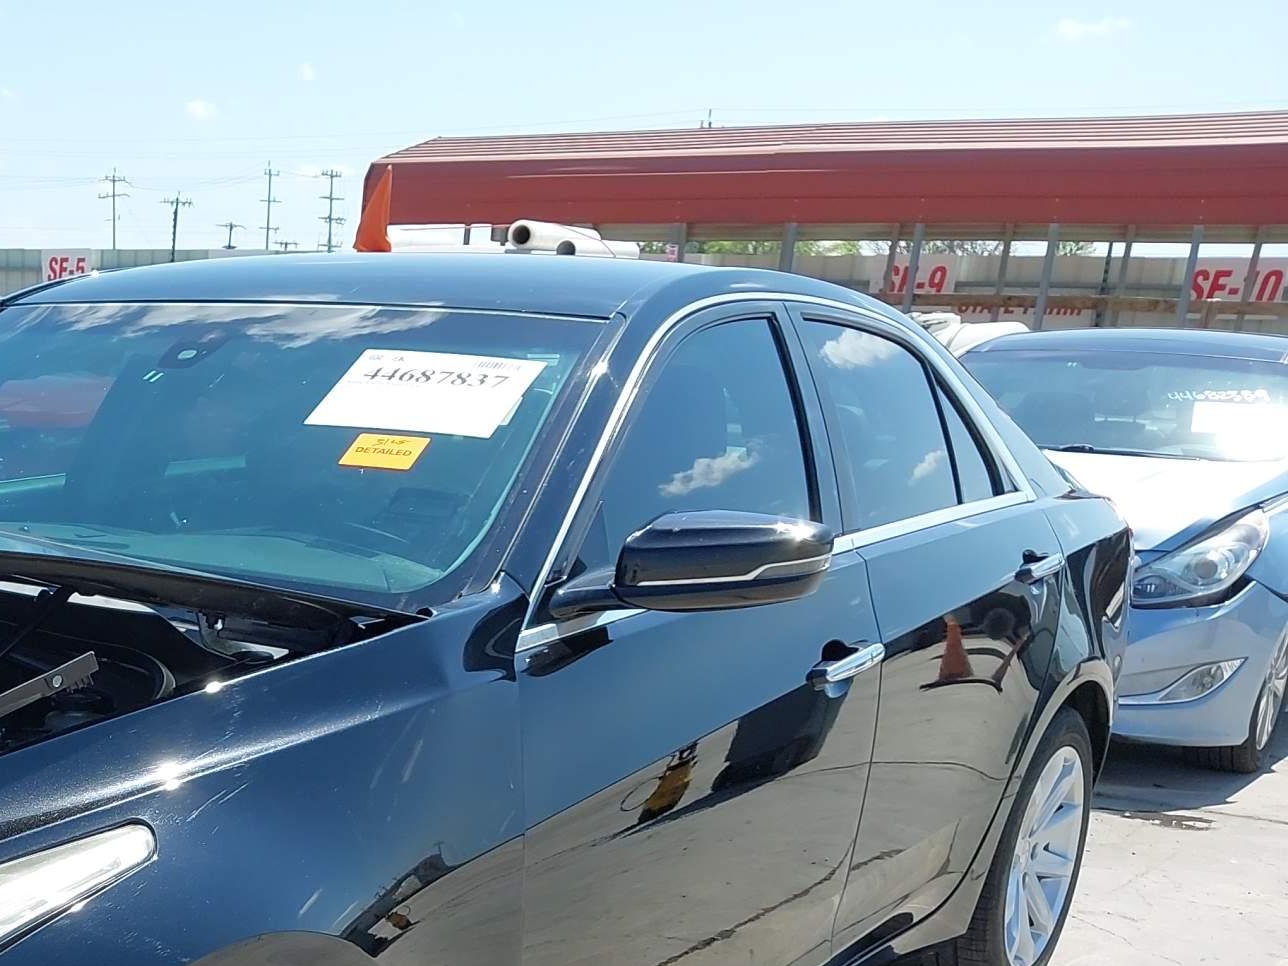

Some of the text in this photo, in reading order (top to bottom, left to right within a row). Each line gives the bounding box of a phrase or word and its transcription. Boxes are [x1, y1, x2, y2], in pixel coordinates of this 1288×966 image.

[47, 256, 86, 281] SF-5
[1191, 268, 1284, 302] SF-0
[363, 367, 511, 389] 44687837
[355, 446, 413, 457] DETAILED
